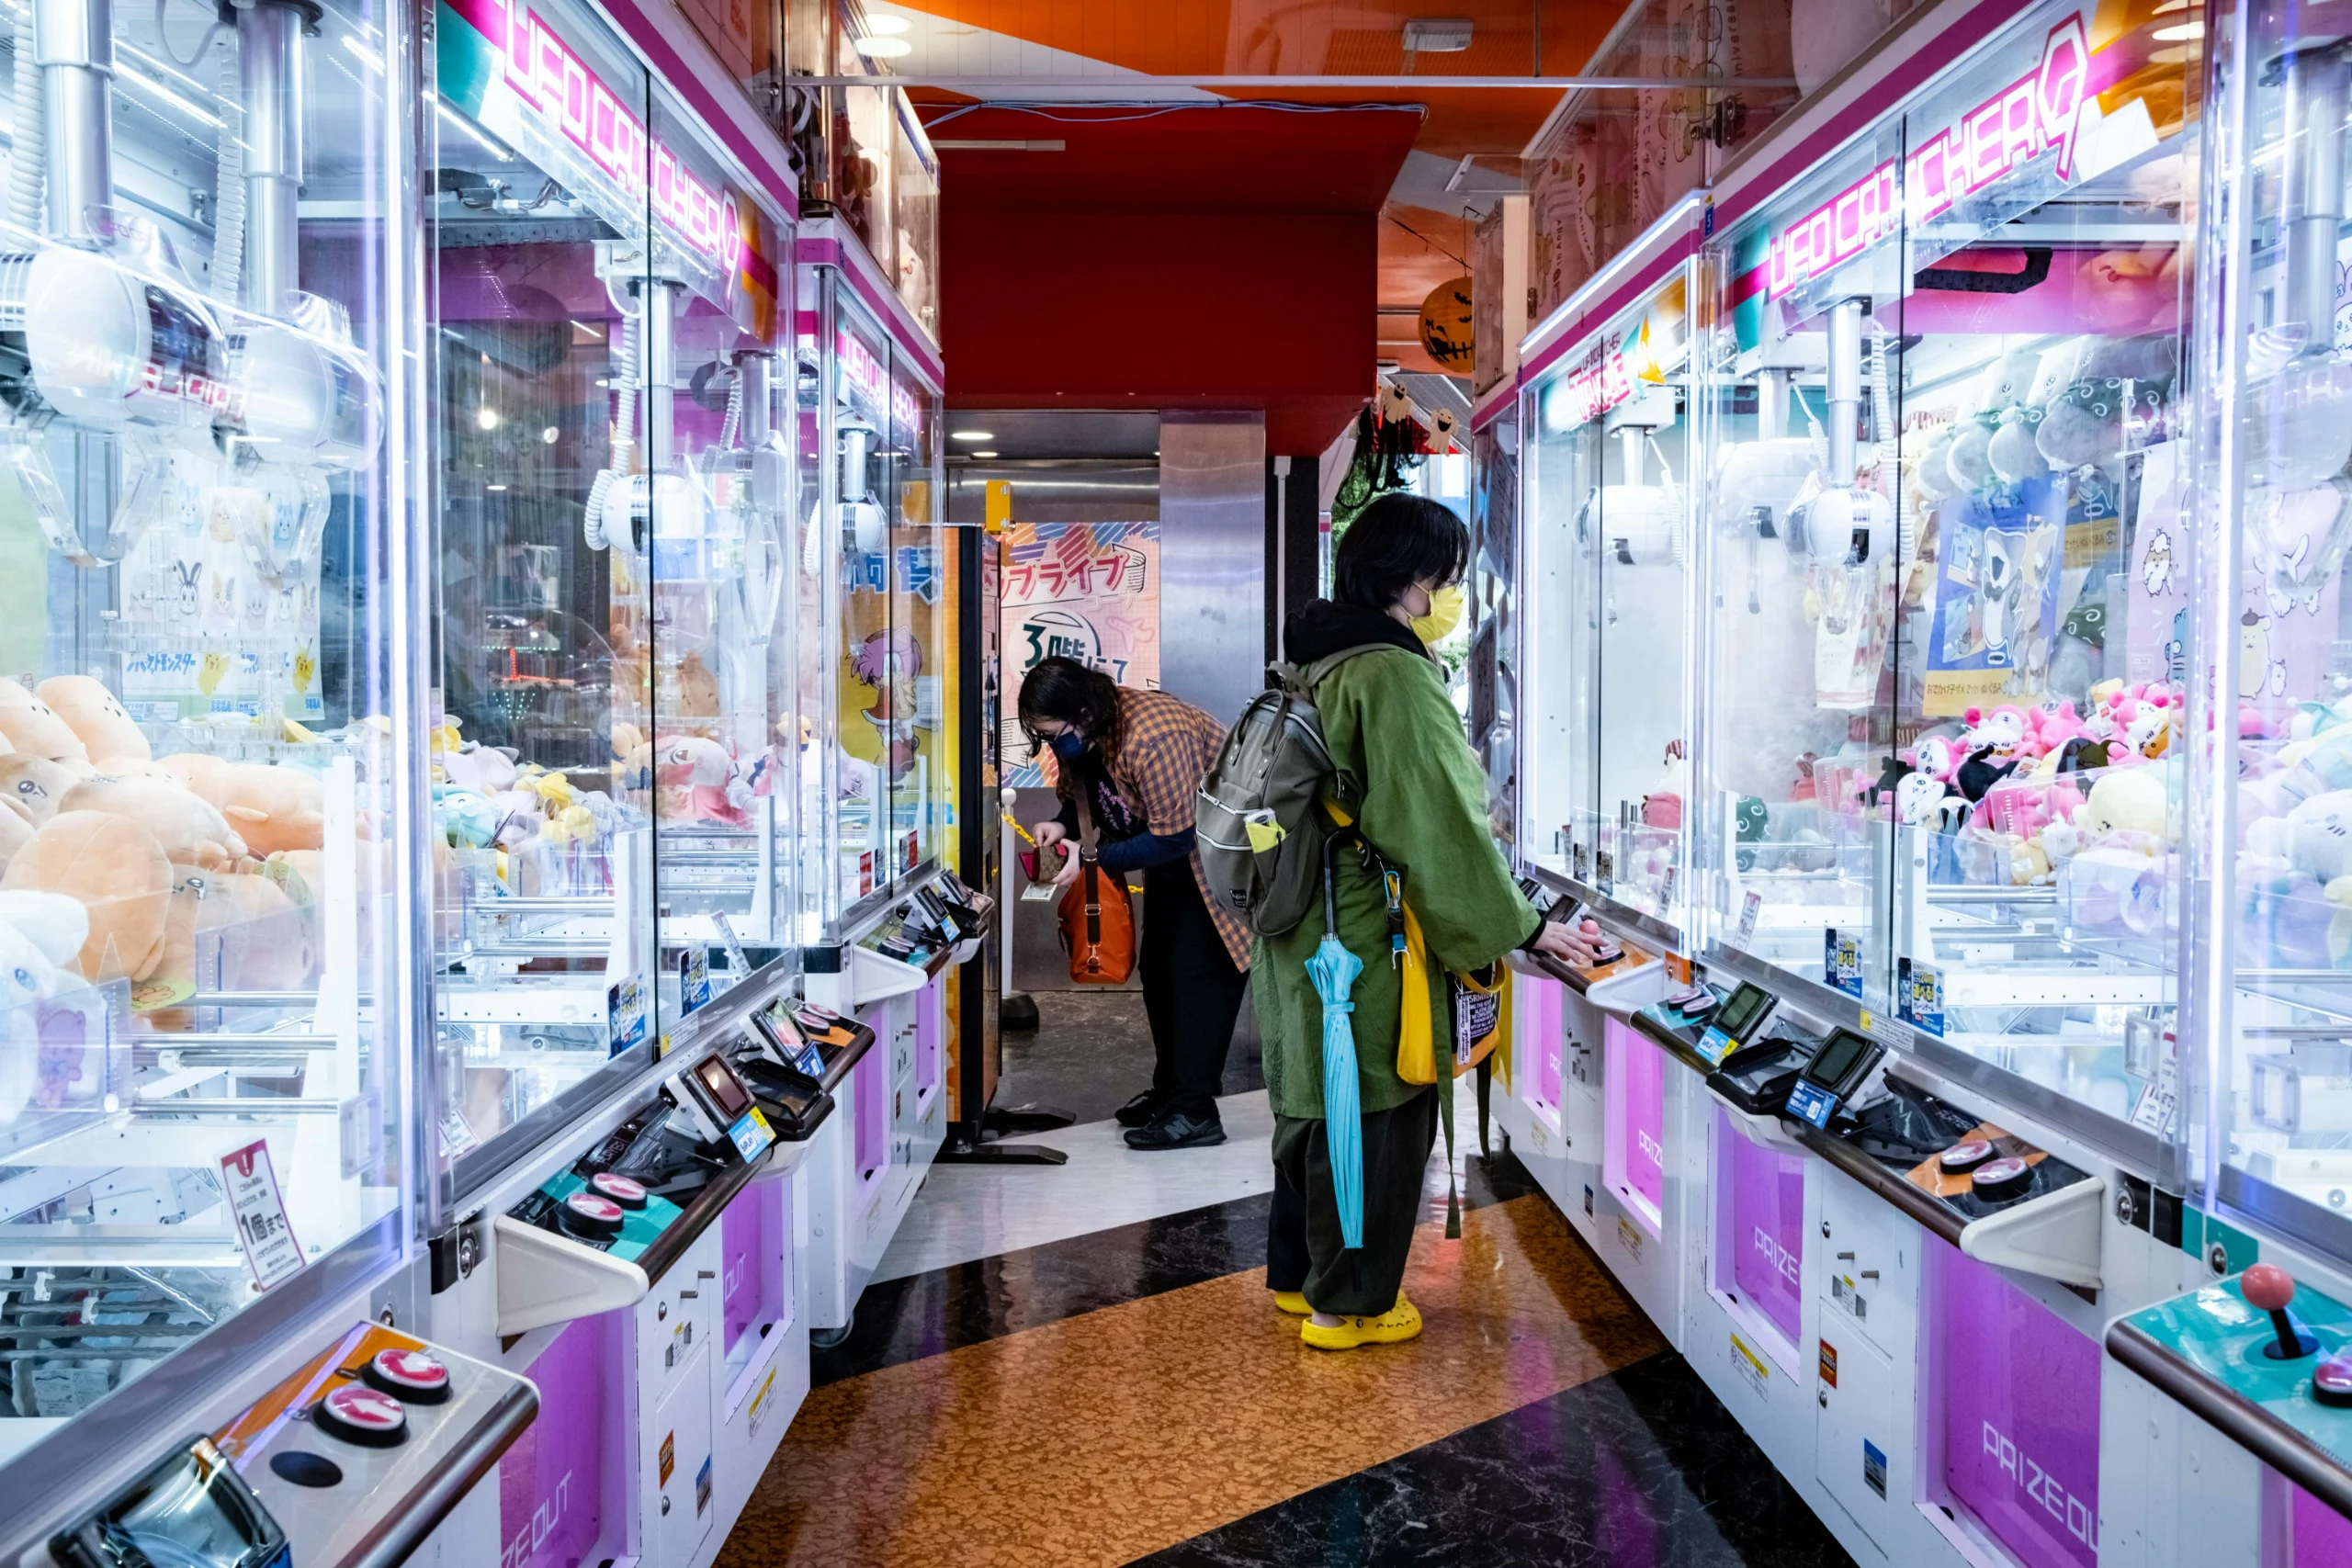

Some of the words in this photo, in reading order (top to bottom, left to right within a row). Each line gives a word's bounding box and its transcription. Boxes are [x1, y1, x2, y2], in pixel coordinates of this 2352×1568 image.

[504, 0, 587, 144] UFO
[1770, 206, 1833, 299] UFO
[1835, 77, 2045, 259] CATCHER
[1085, 589, 1157, 613] コーナー
[210, 700, 232, 712] SEGA
[241, 1213, 286, 1246] 1個まで
[1754, 1224, 1802, 1287] PRIZE
